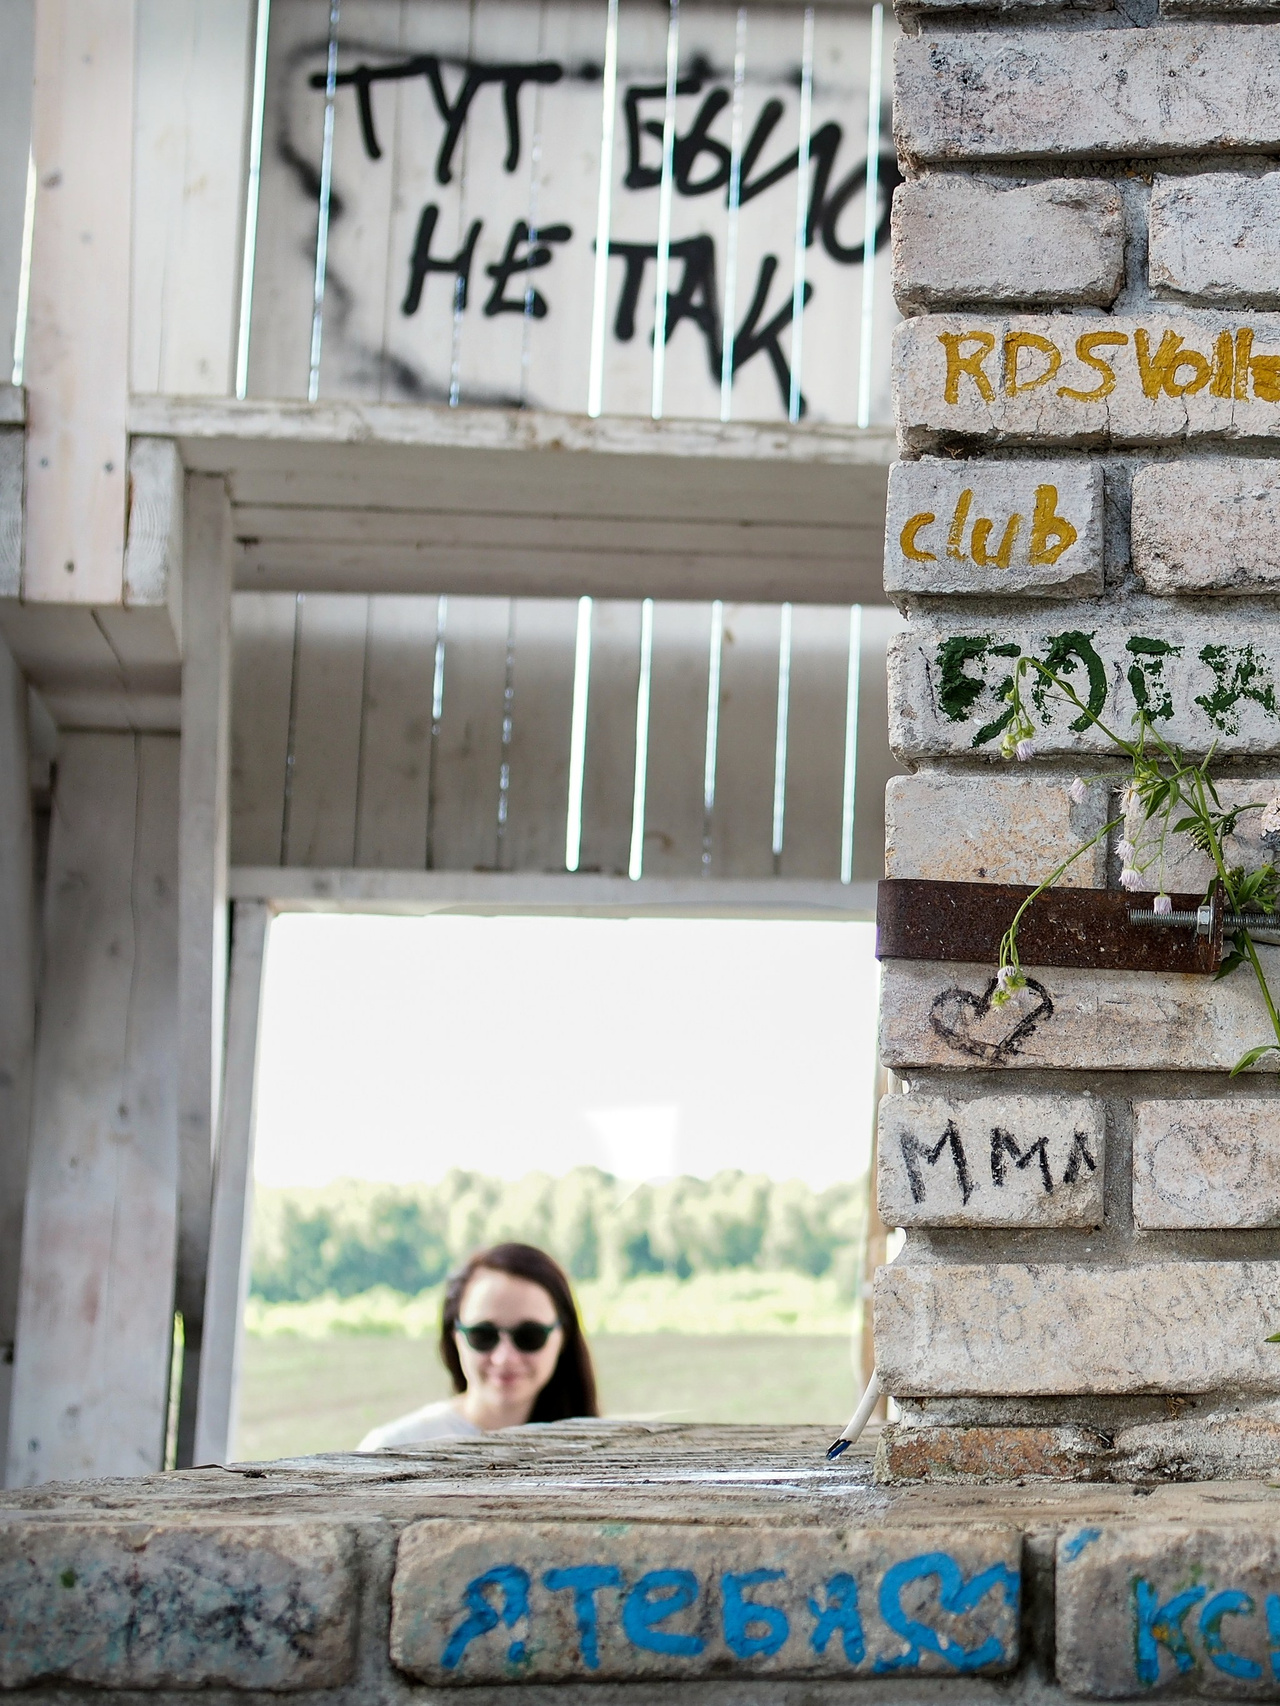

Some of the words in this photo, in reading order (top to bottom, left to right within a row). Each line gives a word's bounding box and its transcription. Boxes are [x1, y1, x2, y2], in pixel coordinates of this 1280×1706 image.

[310, 55, 563, 184] ТУТ
[403, 203, 573, 319] НЕ
[593, 232, 812, 418] ТАК
[900, 484, 1078, 569] club
